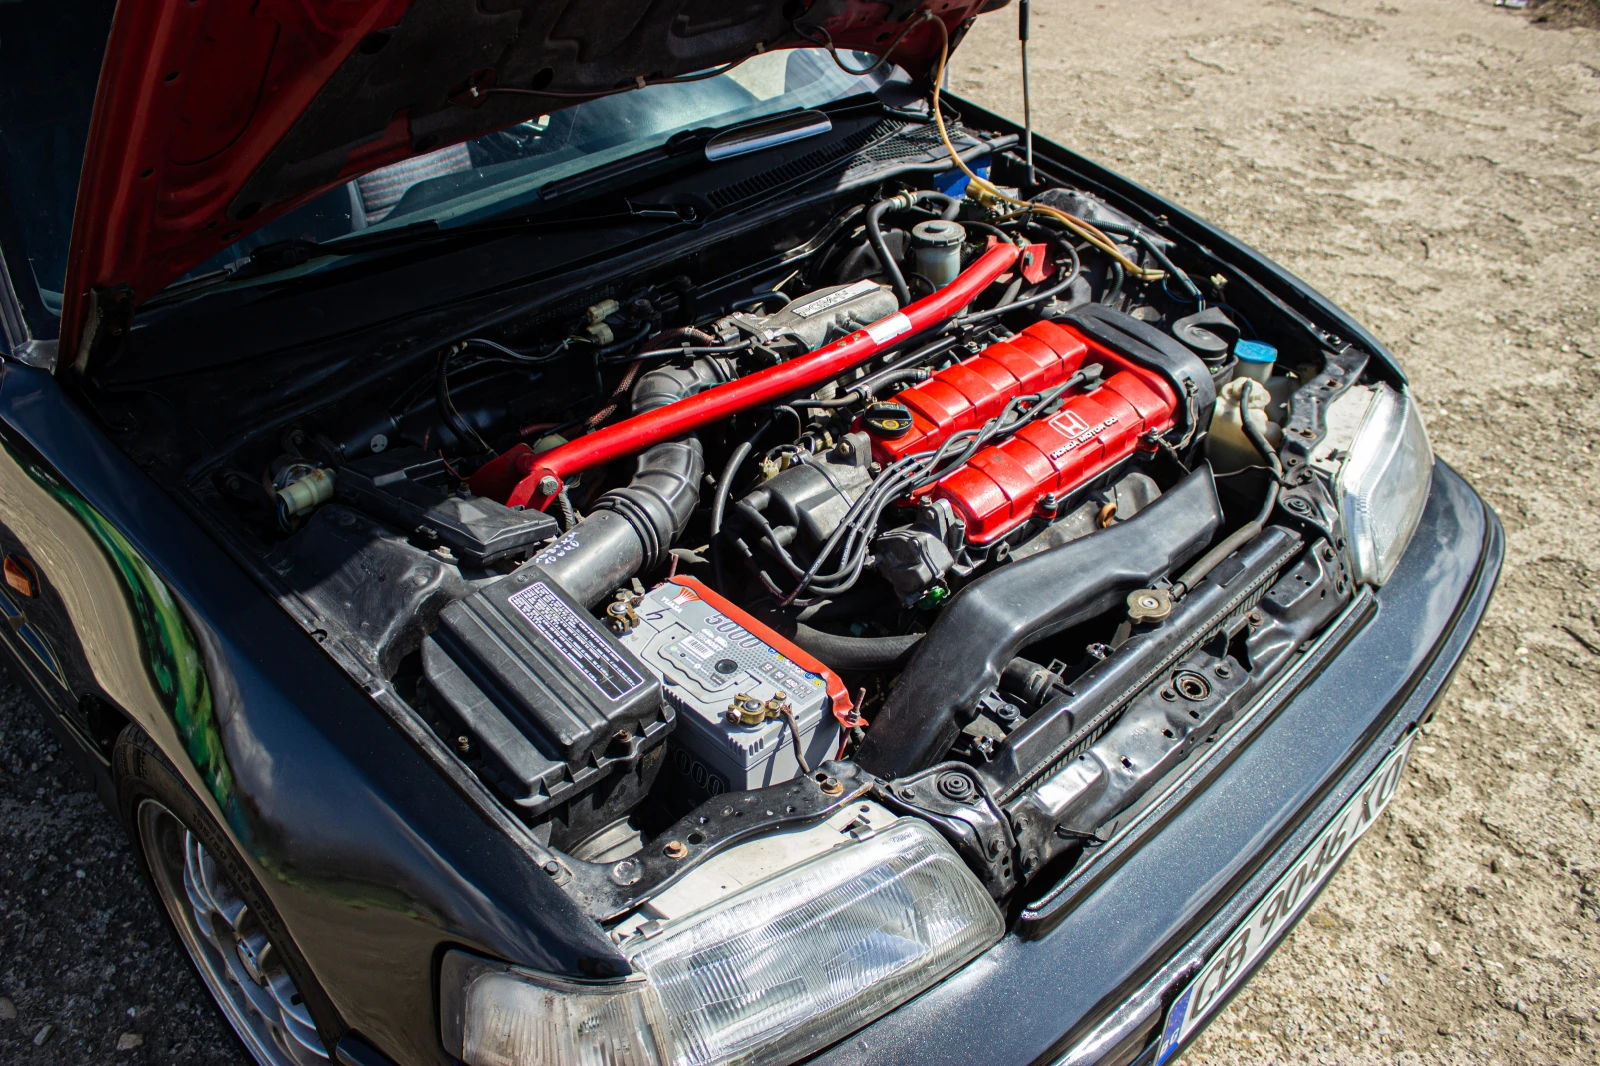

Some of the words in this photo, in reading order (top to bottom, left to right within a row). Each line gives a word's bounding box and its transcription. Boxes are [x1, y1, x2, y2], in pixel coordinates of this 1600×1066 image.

[1050, 441, 1080, 460] HONDA
[1077, 423, 1106, 443] MOTOR
[661, 596, 683, 614] YUASA
[704, 613, 763, 649] 5000
[1189, 926, 1252, 1021] CB
[1259, 807, 1352, 946] 9046
[1161, 1027, 1180, 1054] BG
